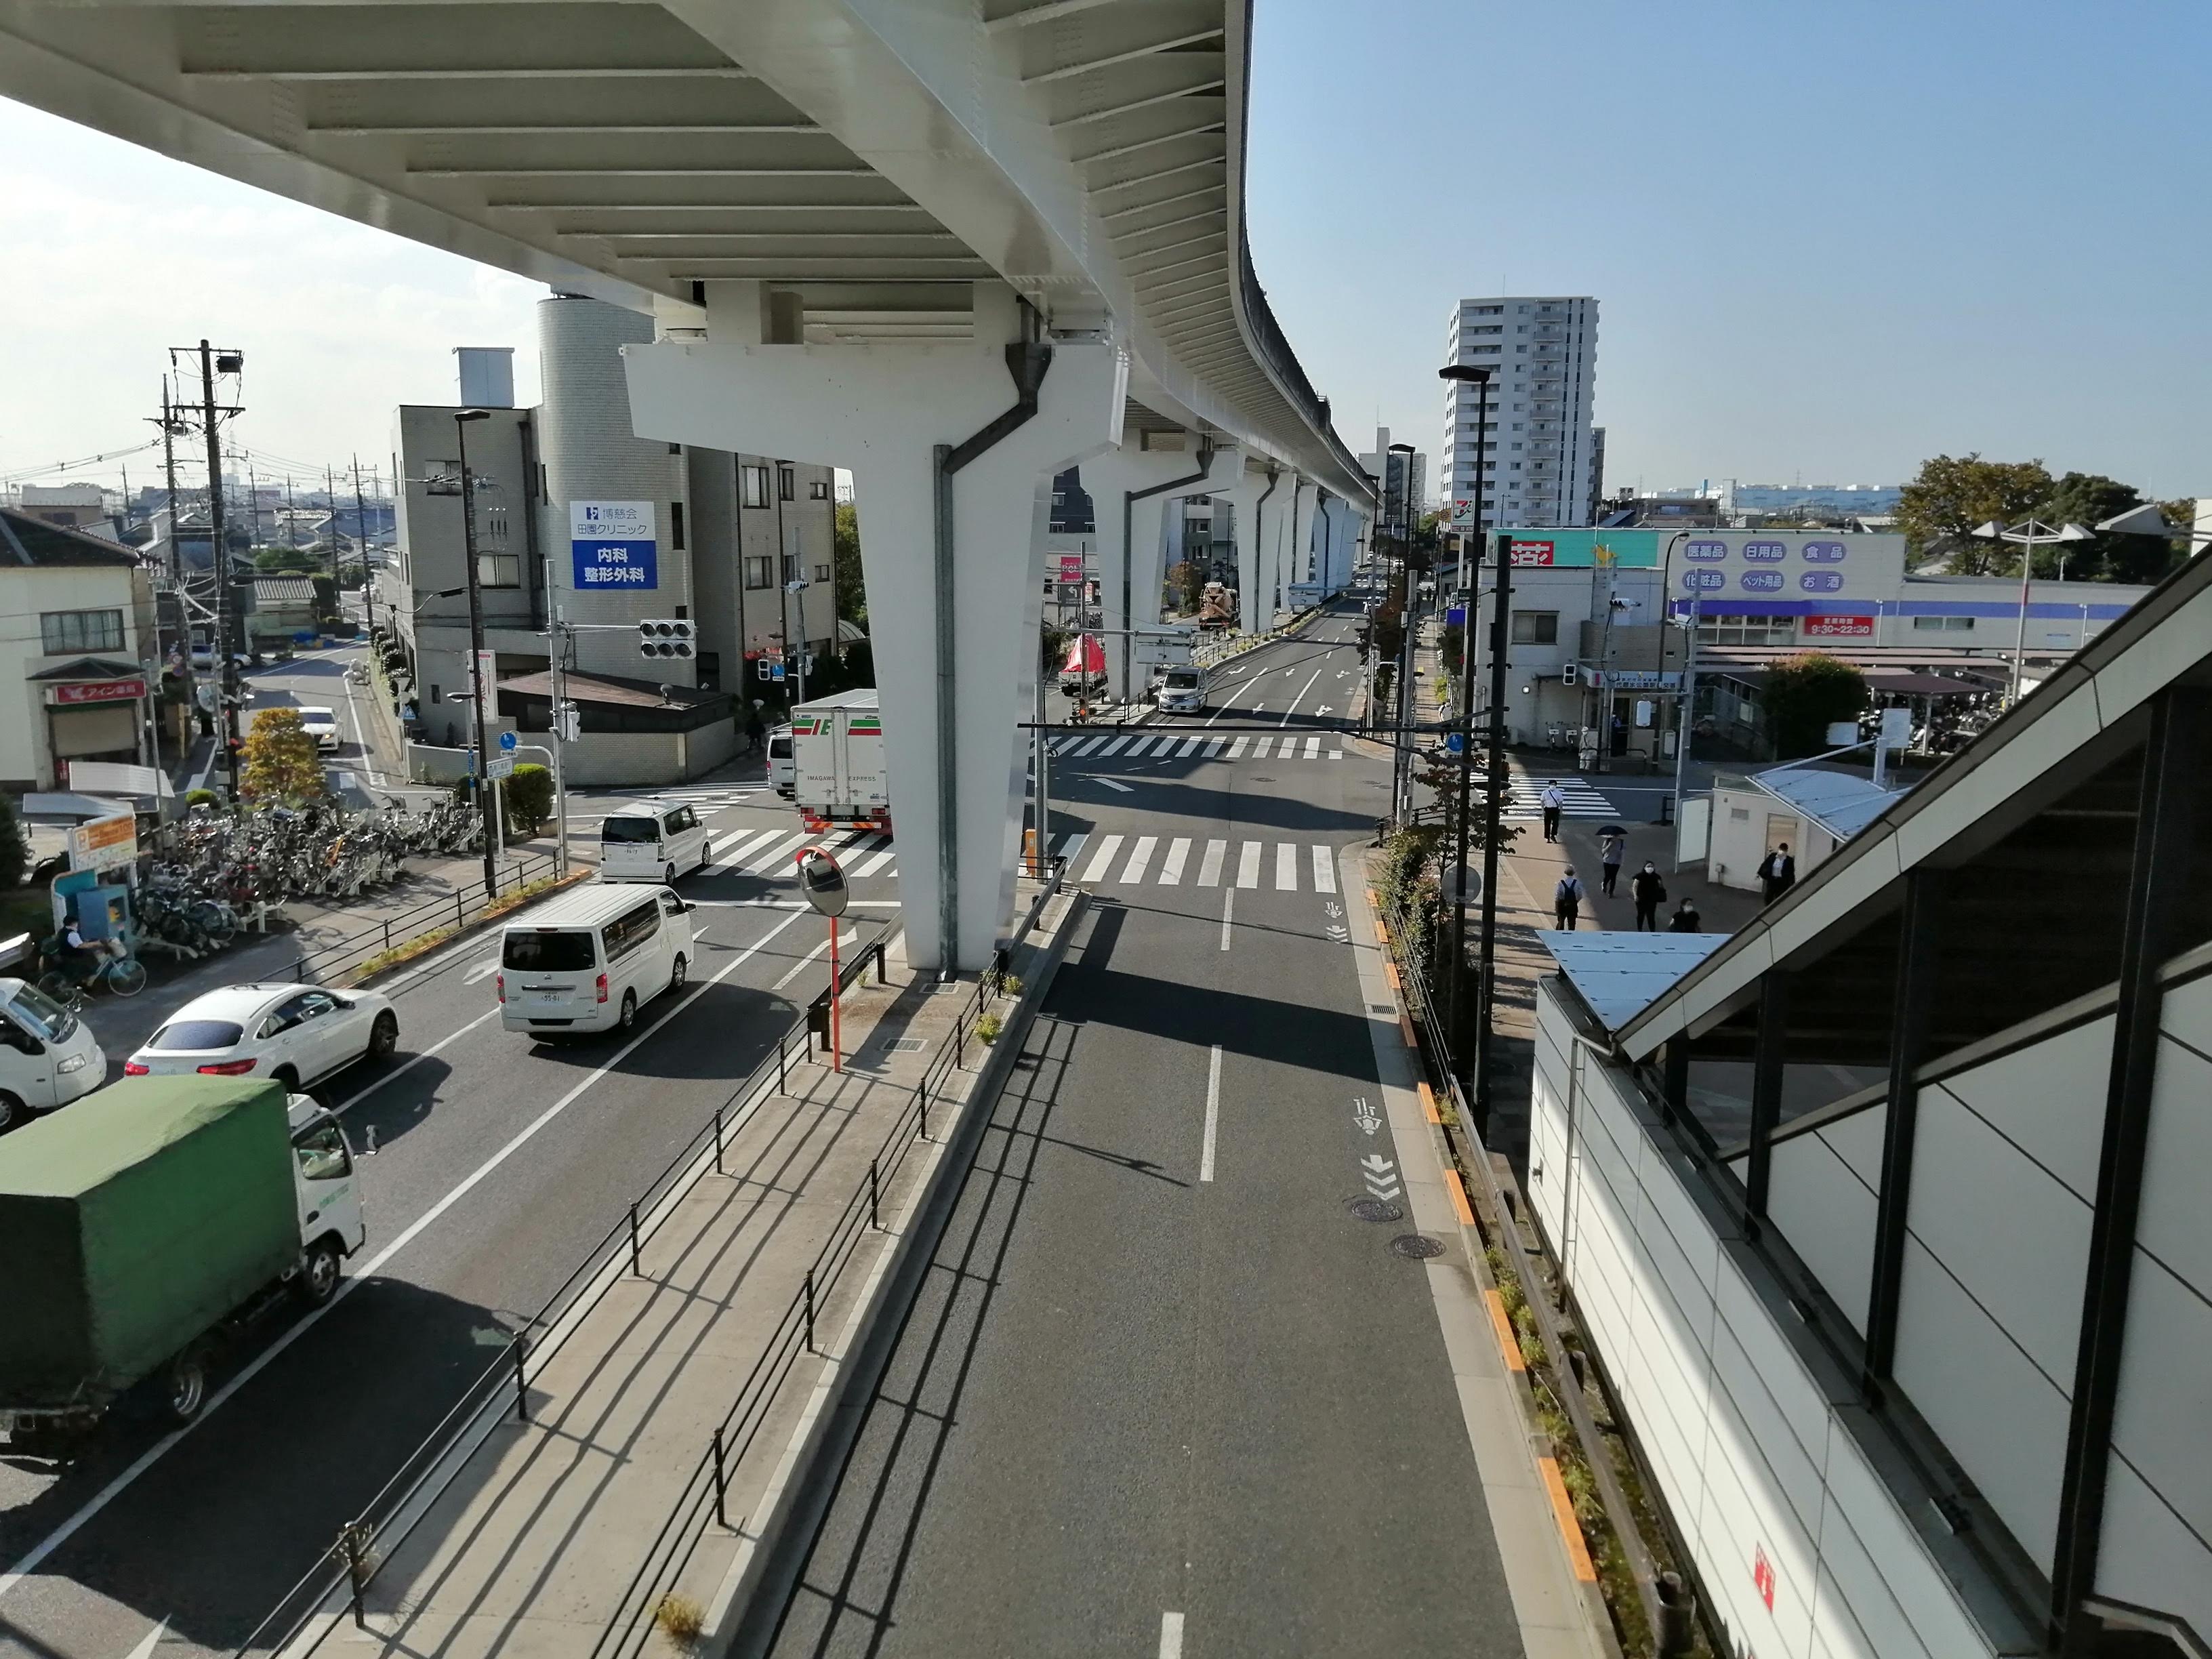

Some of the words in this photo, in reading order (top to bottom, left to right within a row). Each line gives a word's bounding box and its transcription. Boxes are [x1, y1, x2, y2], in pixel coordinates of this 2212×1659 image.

[602, 508, 637, 520] 博慈会
[578, 524, 647, 535] 田園クリニック
[597, 548, 628, 563] 内科
[1687, 546, 1724, 558] 医薬品
[1746, 546, 1783, 558] 日用品
[584, 567, 644, 582] 整形外科
[1743, 575, 1782, 588] ペット用品
